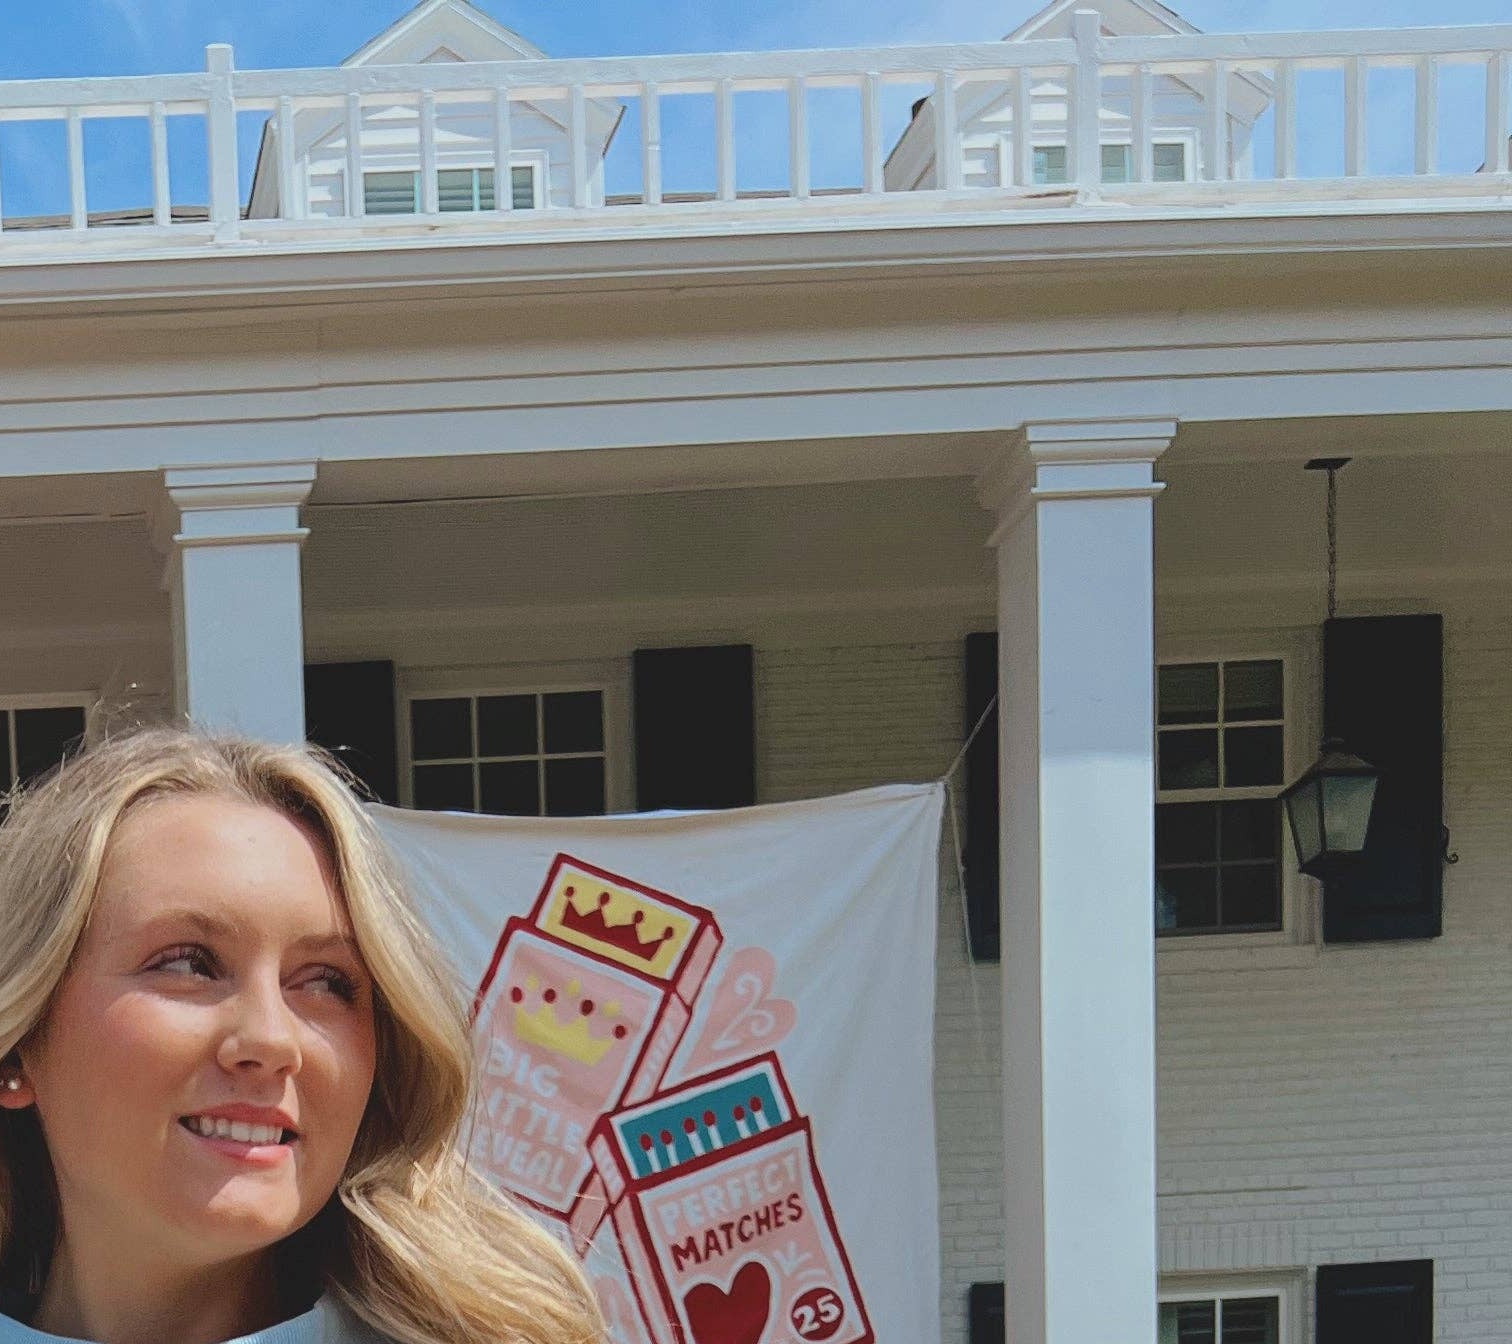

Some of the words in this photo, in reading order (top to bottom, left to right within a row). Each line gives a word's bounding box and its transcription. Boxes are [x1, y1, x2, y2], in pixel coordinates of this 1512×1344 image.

[658, 1147, 798, 1236] PERFECT
[669, 1193, 804, 1272] MATCHES
[793, 1293, 841, 1335] 25
